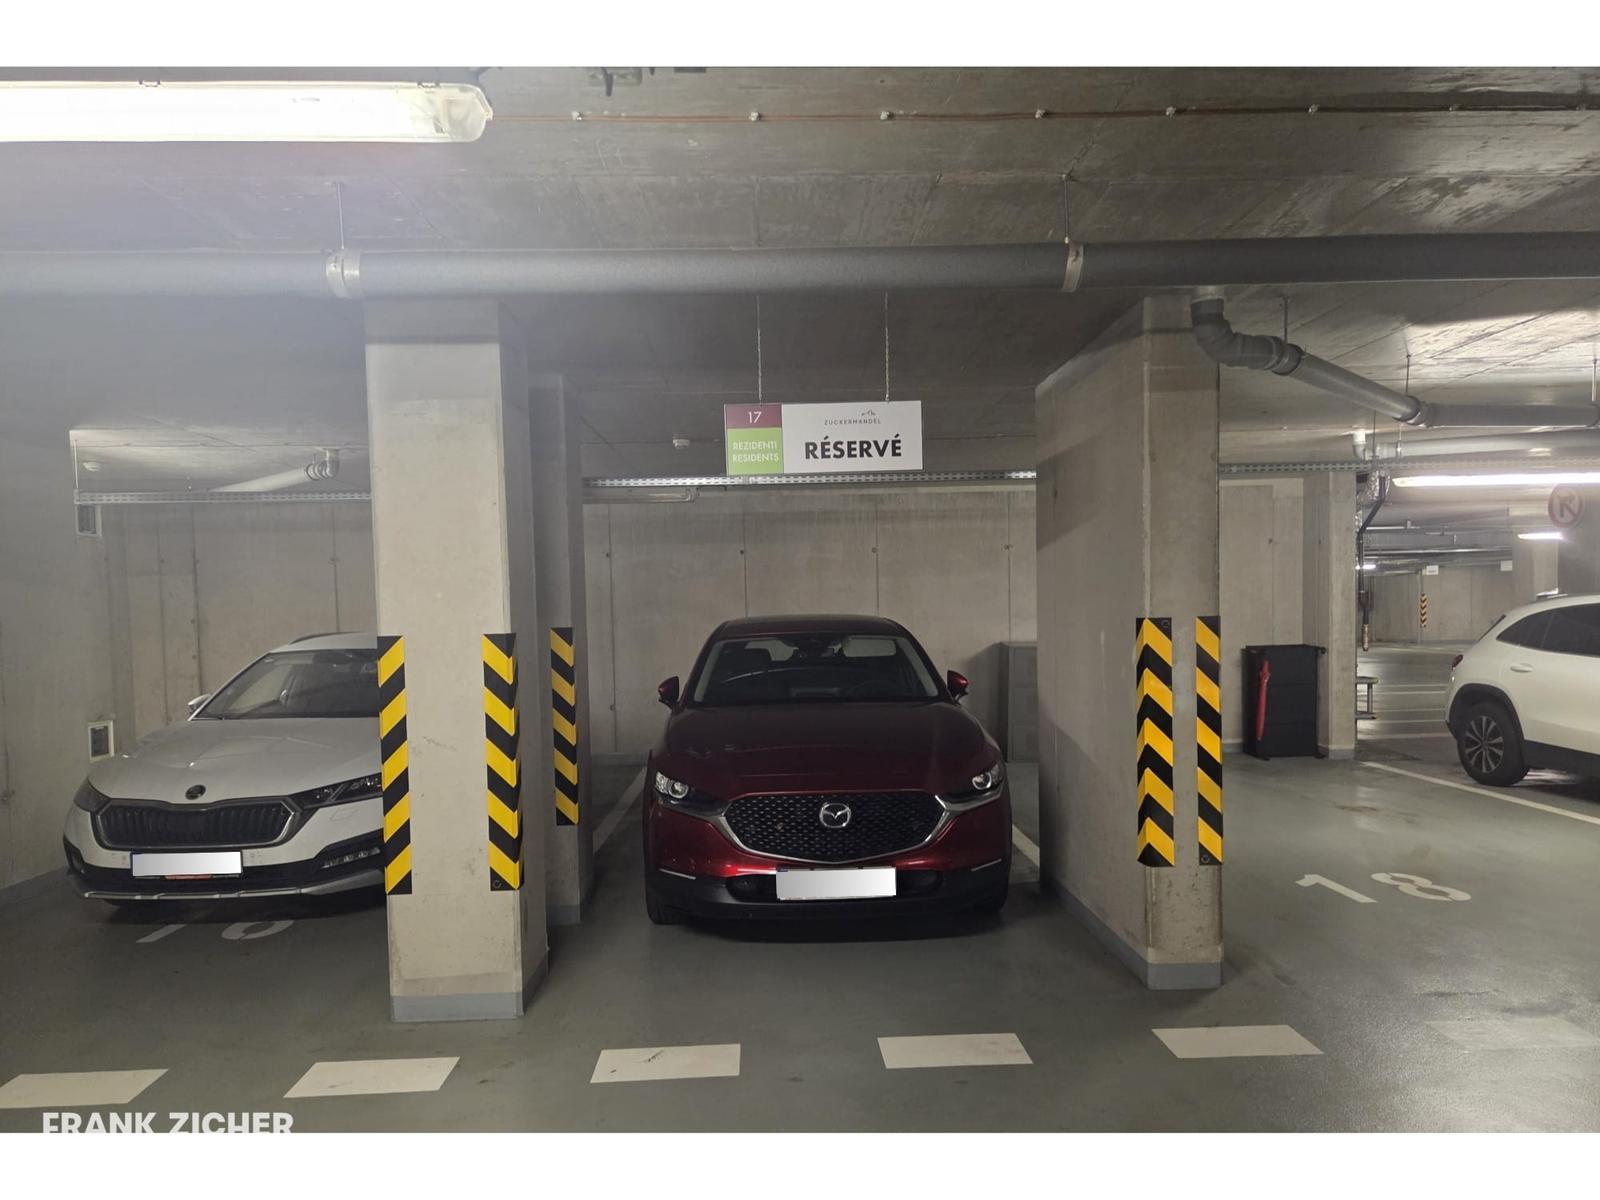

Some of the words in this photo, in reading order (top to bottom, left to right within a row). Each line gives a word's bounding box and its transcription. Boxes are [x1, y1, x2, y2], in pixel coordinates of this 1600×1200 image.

[747, 411, 762, 424] 17
[824, 417, 882, 426] ZUCKERHANDEL
[732, 440, 778, 451] REZIDENTI
[804, 433, 902, 460] RÉSERVÉ
[732, 452, 780, 463] RESIDENTS
[1295, 872, 1472, 903] 18
